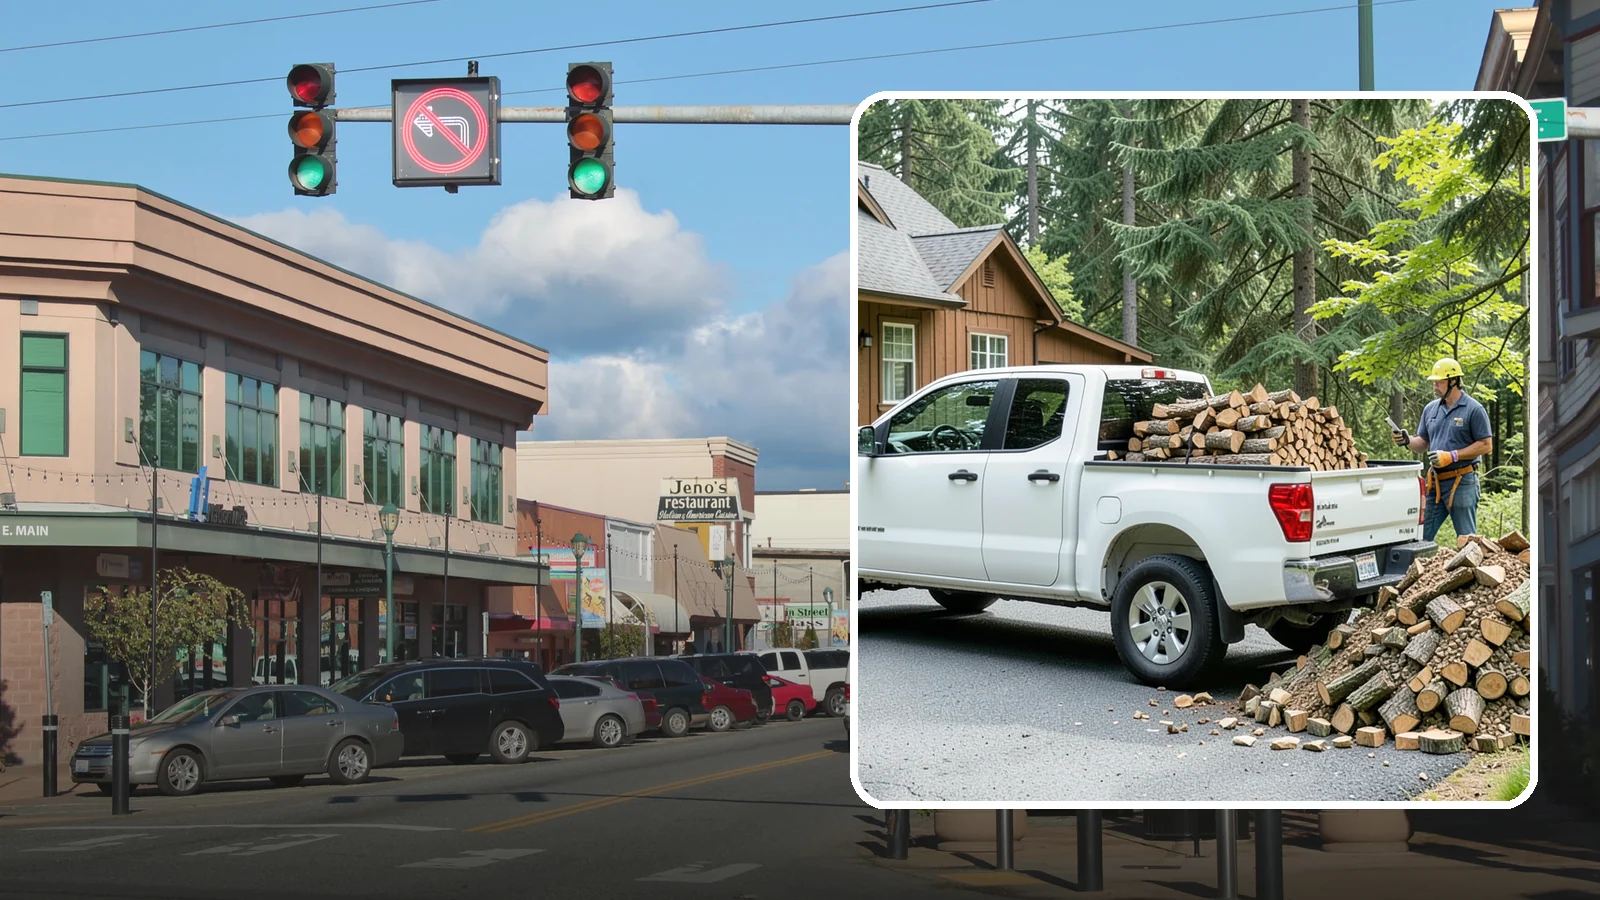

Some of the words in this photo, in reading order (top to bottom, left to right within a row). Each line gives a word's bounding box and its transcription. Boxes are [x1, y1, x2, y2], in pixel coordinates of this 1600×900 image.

[669, 480, 727, 495] Jeno's
[665, 497, 731, 509] restaurant
[659, 509, 681, 519] Italian
[685, 509, 715, 519] American
[715, 509, 737, 519] Cuisine
[2, 525, 13, 536] E.
[15, 525, 49, 536] MAIN
[797, 607, 828, 617] Street
[791, 619, 823, 627] lass
